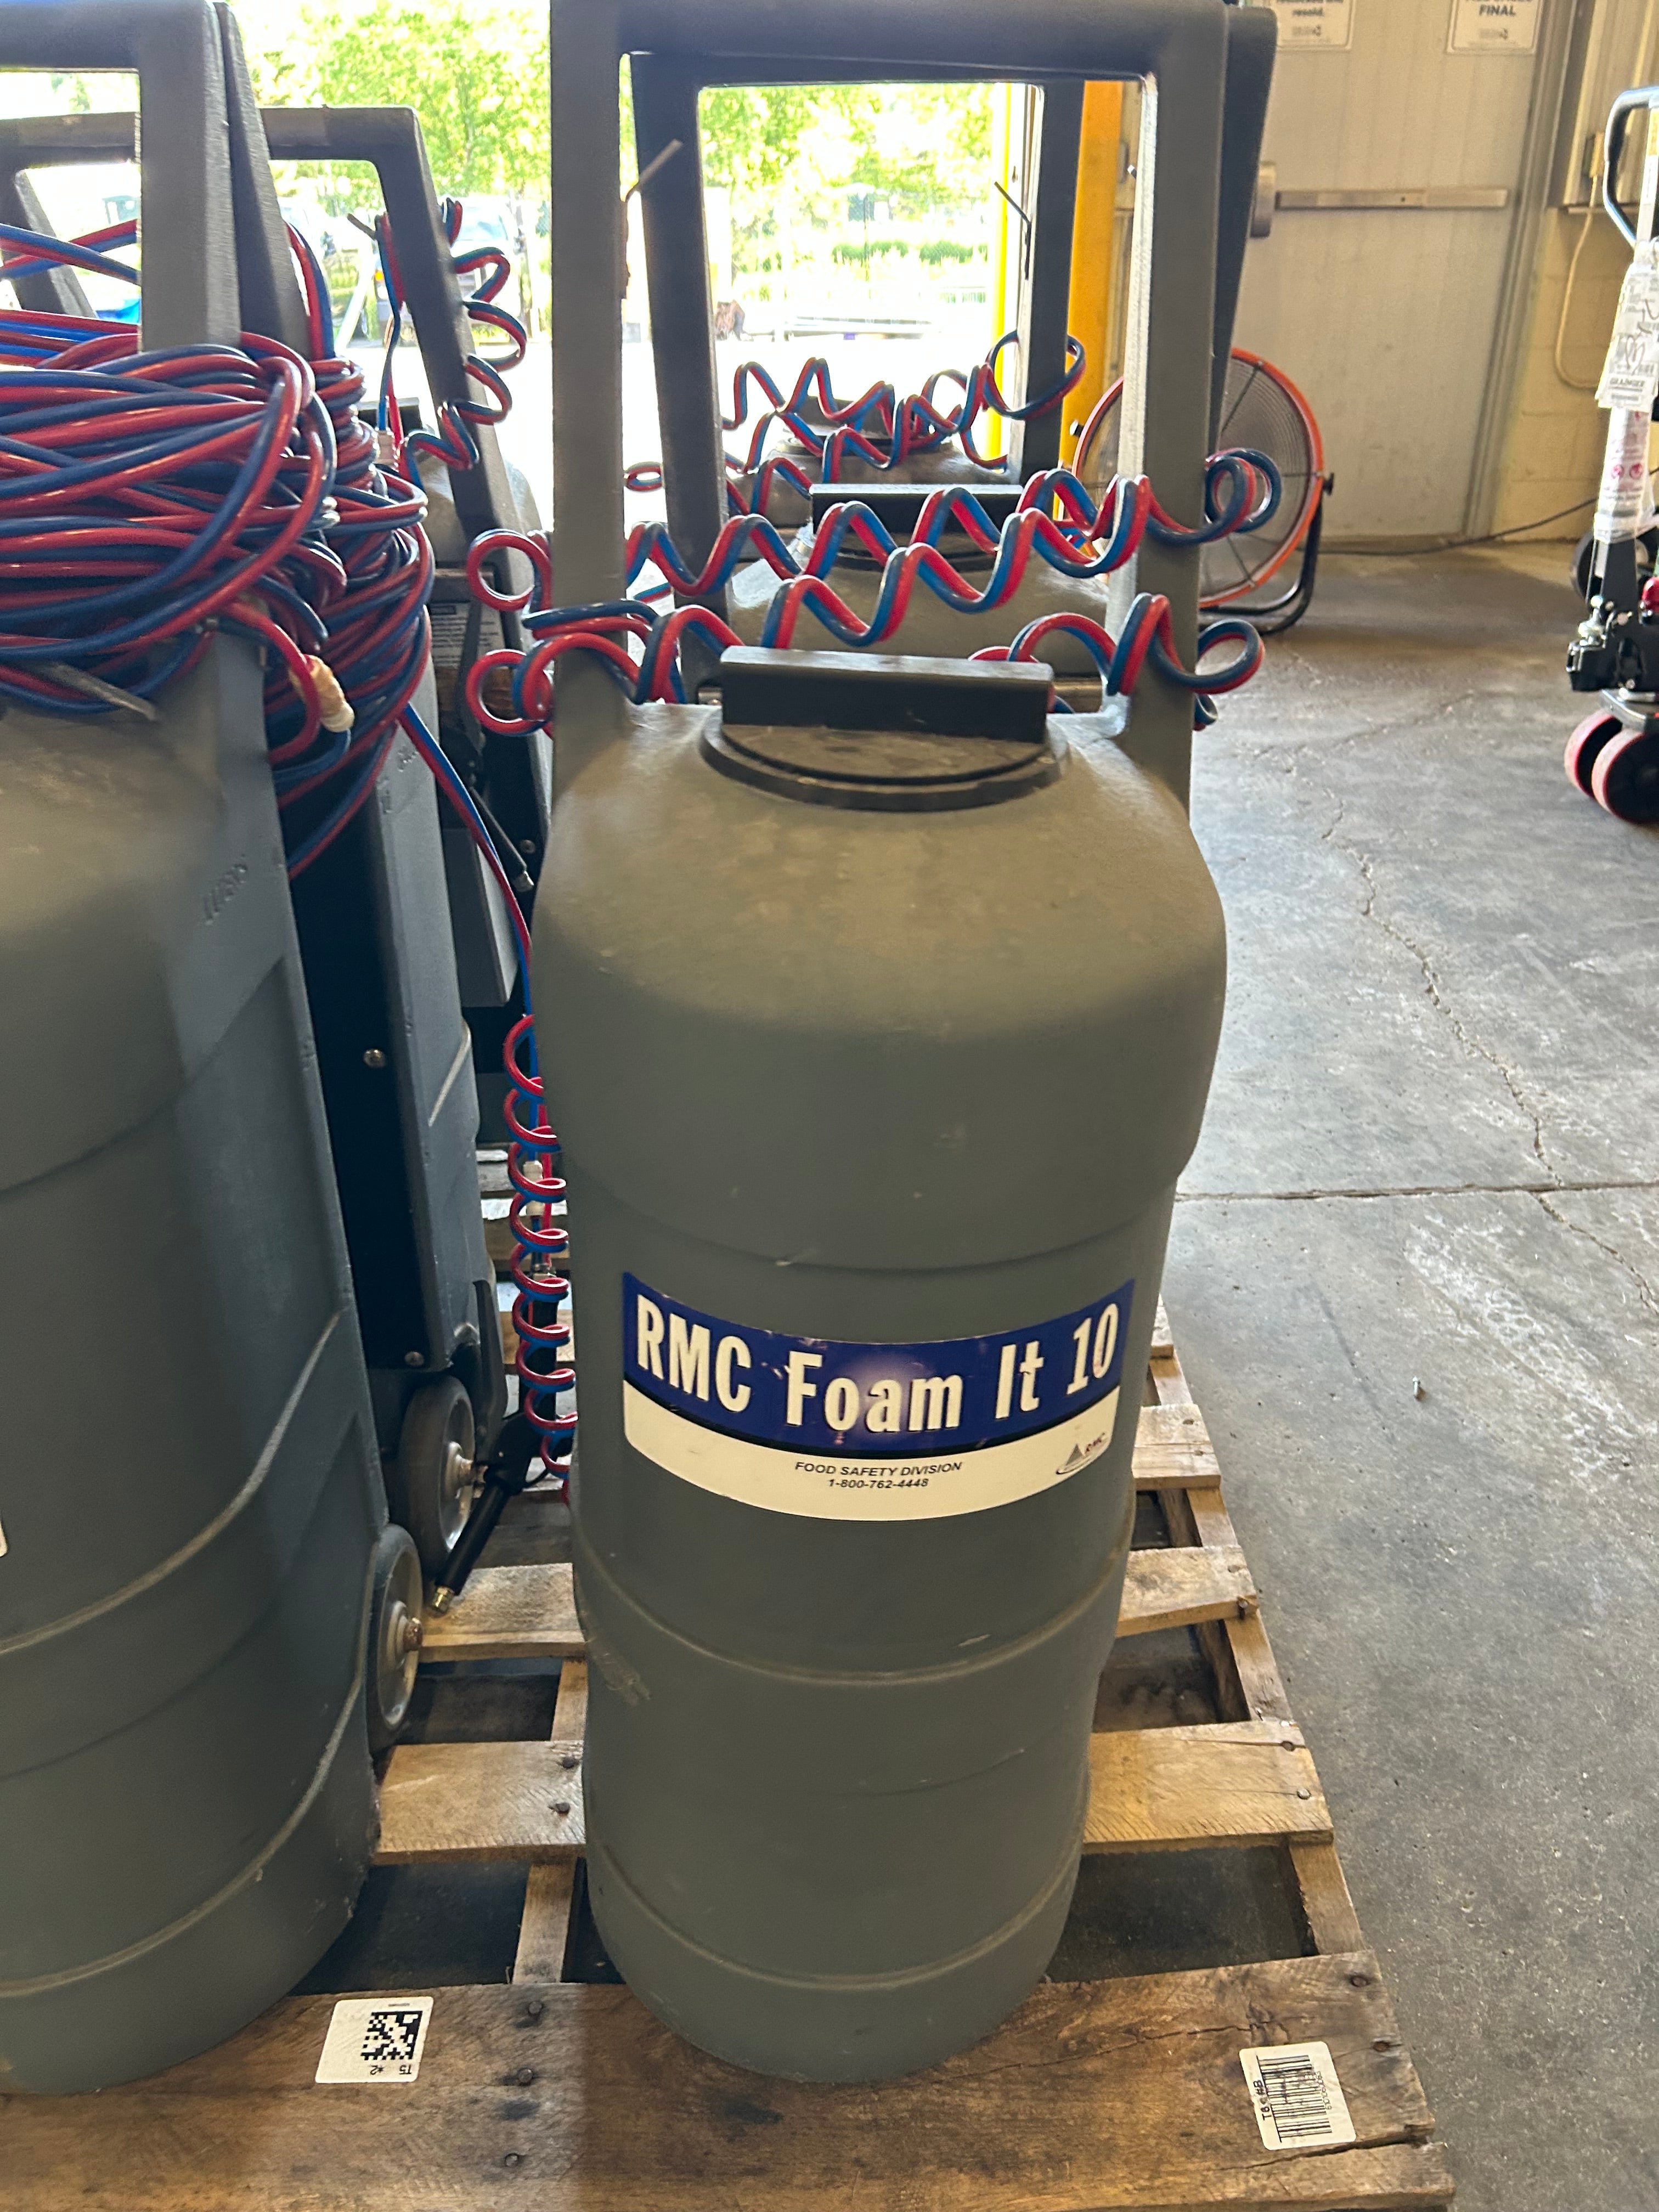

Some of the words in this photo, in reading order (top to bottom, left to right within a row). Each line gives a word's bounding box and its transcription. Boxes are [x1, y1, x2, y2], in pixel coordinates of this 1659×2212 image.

[1479, 4, 1516, 16] FINAL
[637, 1294, 752, 1413] RMC
[787, 1351, 963, 1434] Foam
[995, 1340, 1045, 1420] It
[1065, 1302, 1120, 1396] 10
[795, 1462, 836, 1474] FOOD
[840, 1466, 898, 1476] SAFETY
[900, 1462, 963, 1476] DIVISION
[828, 1479, 929, 1488] 1-800-762-4448
[399, 2064, 412, 2075] T5
